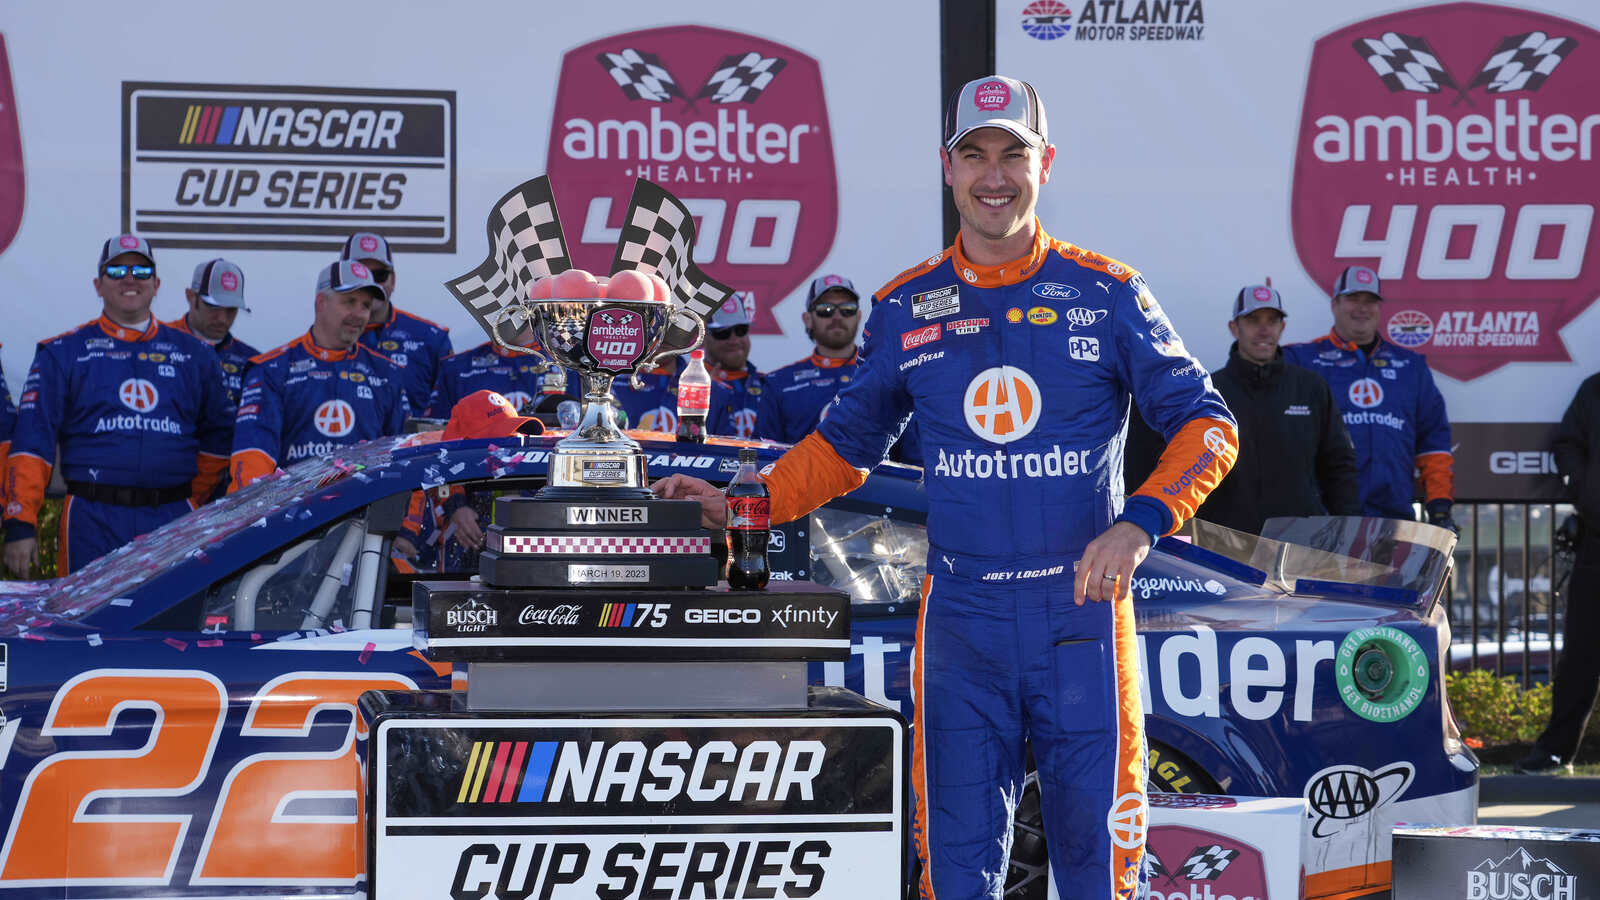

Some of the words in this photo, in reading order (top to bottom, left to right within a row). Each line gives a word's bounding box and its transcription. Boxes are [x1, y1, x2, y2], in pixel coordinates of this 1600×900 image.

[1078, 0, 1204, 24] ATLANTA
[1075, 26, 1127, 41] MOTOR
[1129, 26, 1204, 41] SPEEDWAY
[233, 107, 404, 149] NASCAR
[563, 107, 809, 164] ambetter
[1312, 99, 1600, 162] ambetter
[637, 165, 742, 184] HEALTH
[1400, 167, 1523, 186] HEALTH
[175, 168, 260, 208] CUP
[264, 171, 408, 210] SERIES
[1334, 204, 1595, 280] 400
[927, 288, 953, 301] NASCAR
[1041, 283, 1071, 299] Ford
[592, 324, 638, 336] ambetter
[1433, 311, 1540, 333] ATLANTA
[595, 341, 637, 355] 400
[1070, 337, 1099, 358] PPG
[1433, 333, 1475, 346] MOTOR
[1477, 333, 1540, 347] SPEEDWAY
[899, 351, 945, 371] GOODYEAR
[94, 413, 182, 434] Autotrader
[935, 444, 1092, 480] Autotrader
[572, 508, 643, 522] WINNER
[573, 569, 608, 578] MARCH
[625, 569, 646, 578] 2023
[982, 571, 1013, 581] JOEY
[1016, 565, 1064, 579] LOGANO
[446, 610, 498, 625] BUSCH
[518, 600, 584, 625] Coca-Cola
[632, 603, 671, 628] 75
[684, 608, 761, 624] GEICO
[771, 604, 839, 628] xfinity
[0, 668, 420, 886] 22
[547, 740, 827, 802] NASCAR
[1317, 771, 1371, 817] AAA
[449, 842, 592, 900] CUP
[595, 840, 832, 900] SERIES
[1466, 871, 1578, 900] BUSCH
